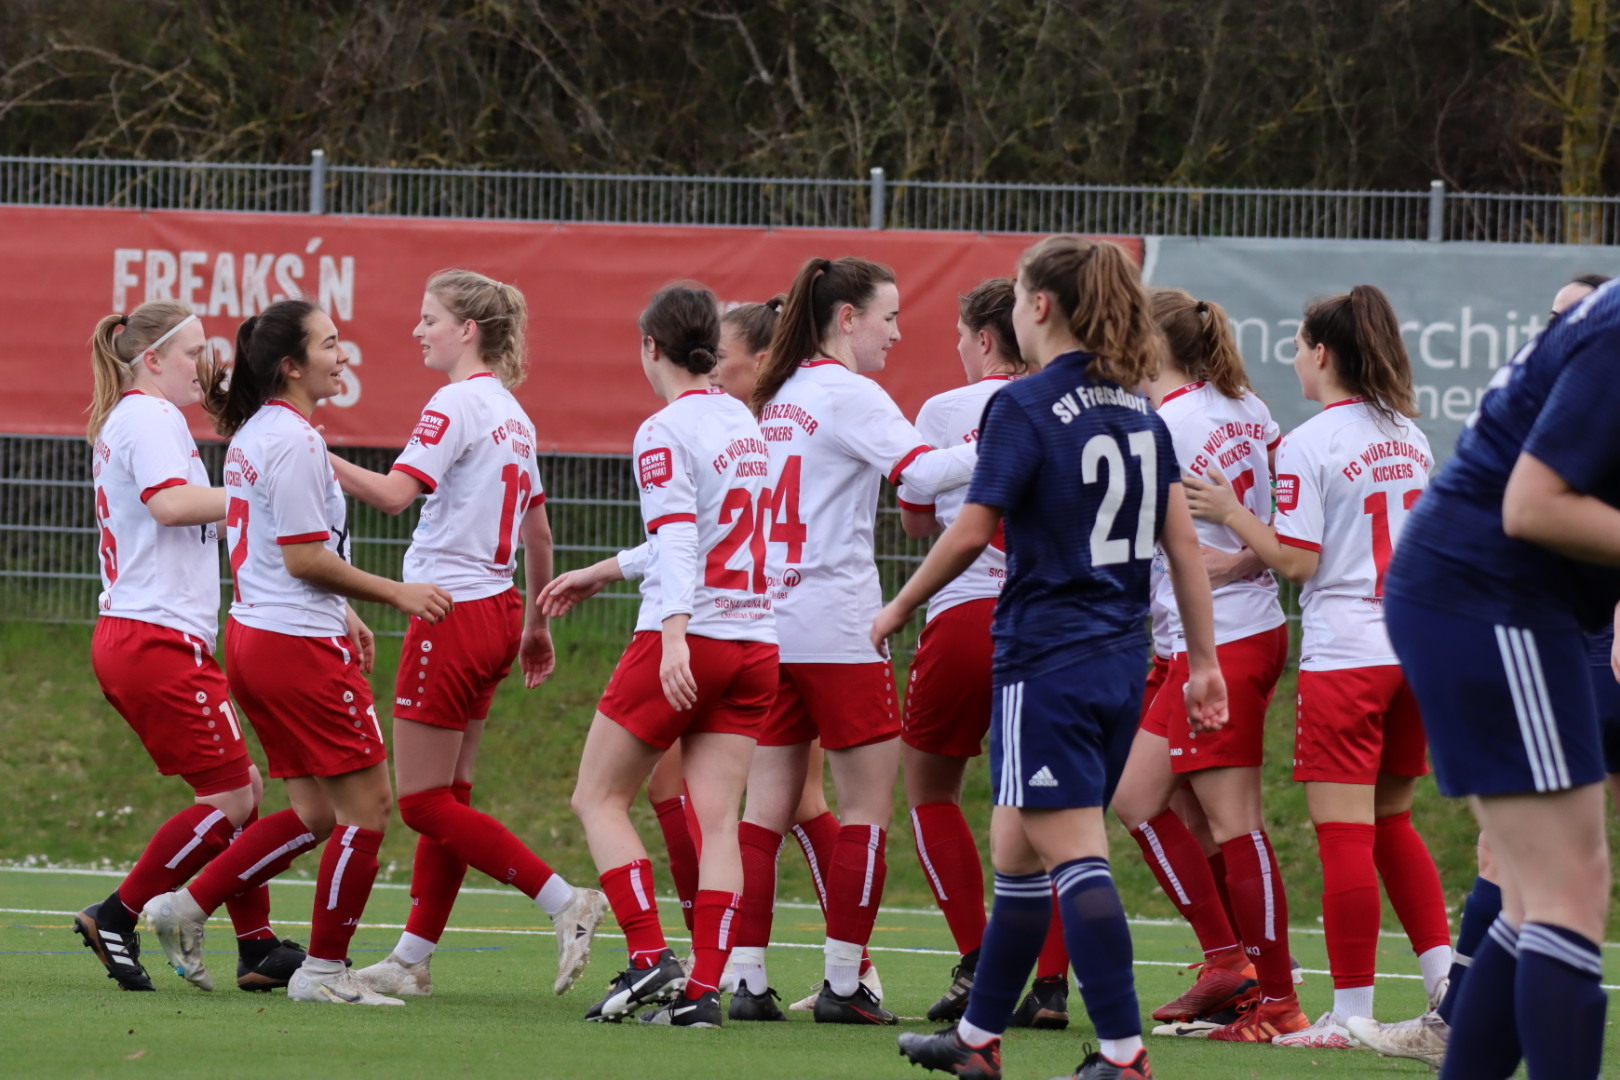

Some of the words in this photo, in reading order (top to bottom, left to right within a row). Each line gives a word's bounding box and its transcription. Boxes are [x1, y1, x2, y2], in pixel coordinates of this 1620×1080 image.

[1052, 392, 1081, 424] SV
[420, 414, 445, 427] REWE
[491, 425, 507, 446] FC
[641, 452, 666, 467] REWE
[712, 454, 728, 475] FC
[736, 461, 768, 477] KICKERS
[1190, 455, 1209, 476] FC
[1342, 461, 1362, 482] FC
[1372, 463, 1414, 483] KICKERS
[1081, 430, 1158, 567] 21
[988, 567, 1008, 578] SIG
